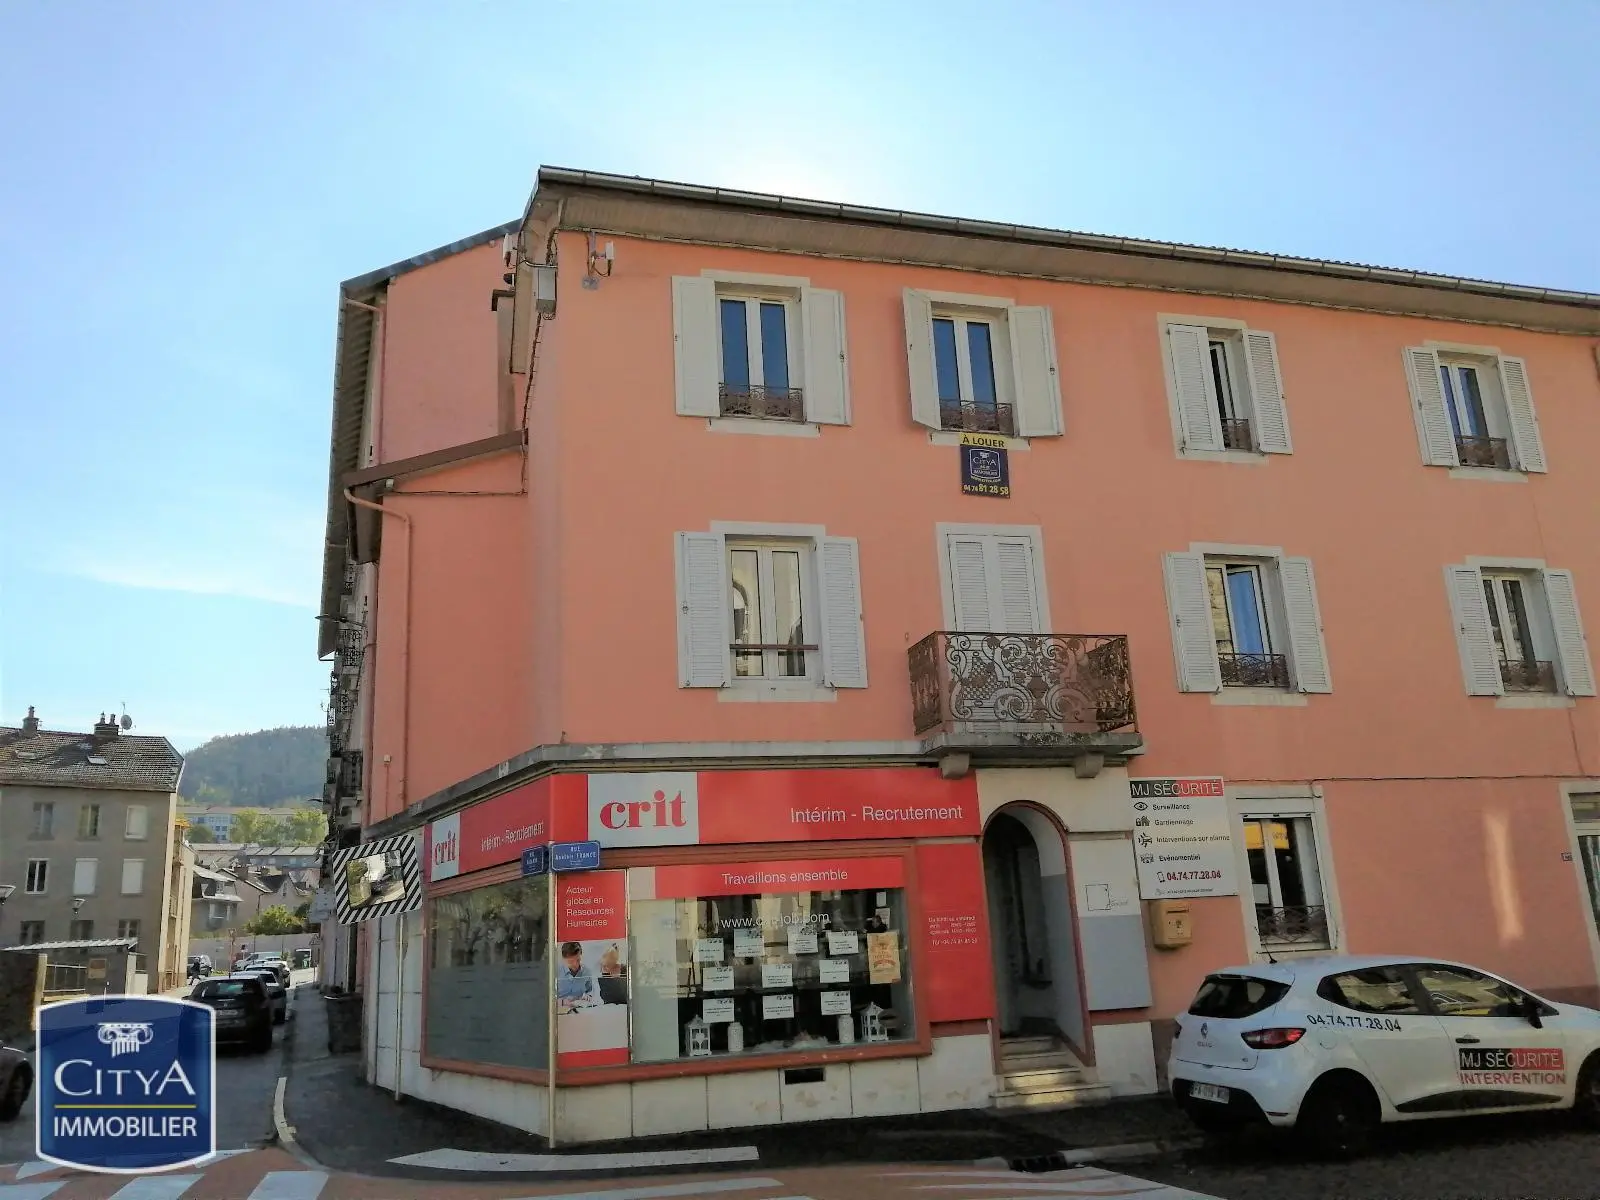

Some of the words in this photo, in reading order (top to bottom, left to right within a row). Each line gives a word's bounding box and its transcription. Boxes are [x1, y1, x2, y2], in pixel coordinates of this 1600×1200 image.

[962, 434, 969, 444] À
[972, 437, 1004, 447] LOUER
[979, 483, 987, 493] 81
[989, 485, 999, 494] 28
[1000, 486, 1009, 495] 58
[1131, 783, 1150, 796] MJ
[1154, 780, 1221, 796] SÉCURITÉ
[600, 789, 687, 830] crit
[1152, 803, 1190, 811] Surveillance
[790, 807, 846, 824] Intérim
[862, 805, 963, 821] Recrutement
[481, 834, 501, 852] Intérim
[505, 821, 544, 844] Recrutement
[434, 830, 457, 866] crit
[576, 851, 597, 859] FRANCE
[722, 872, 786, 885] Travaillons
[789, 869, 848, 881] ensemble
[1167, 870, 1221, 880] 04.74.77.28.04
[566, 886, 593, 894] Acteur
[566, 897, 591, 907] global
[566, 907, 615, 916] Ressources
[566, 919, 608, 928] Humaines
[1306, 1014, 1402, 1032] 04.74.77.28.04
[1461, 1052, 1481, 1068] MJ
[1485, 1048, 1561, 1068] SÉCURITÉ
[1459, 1072, 1567, 1085] INTERVENTION
